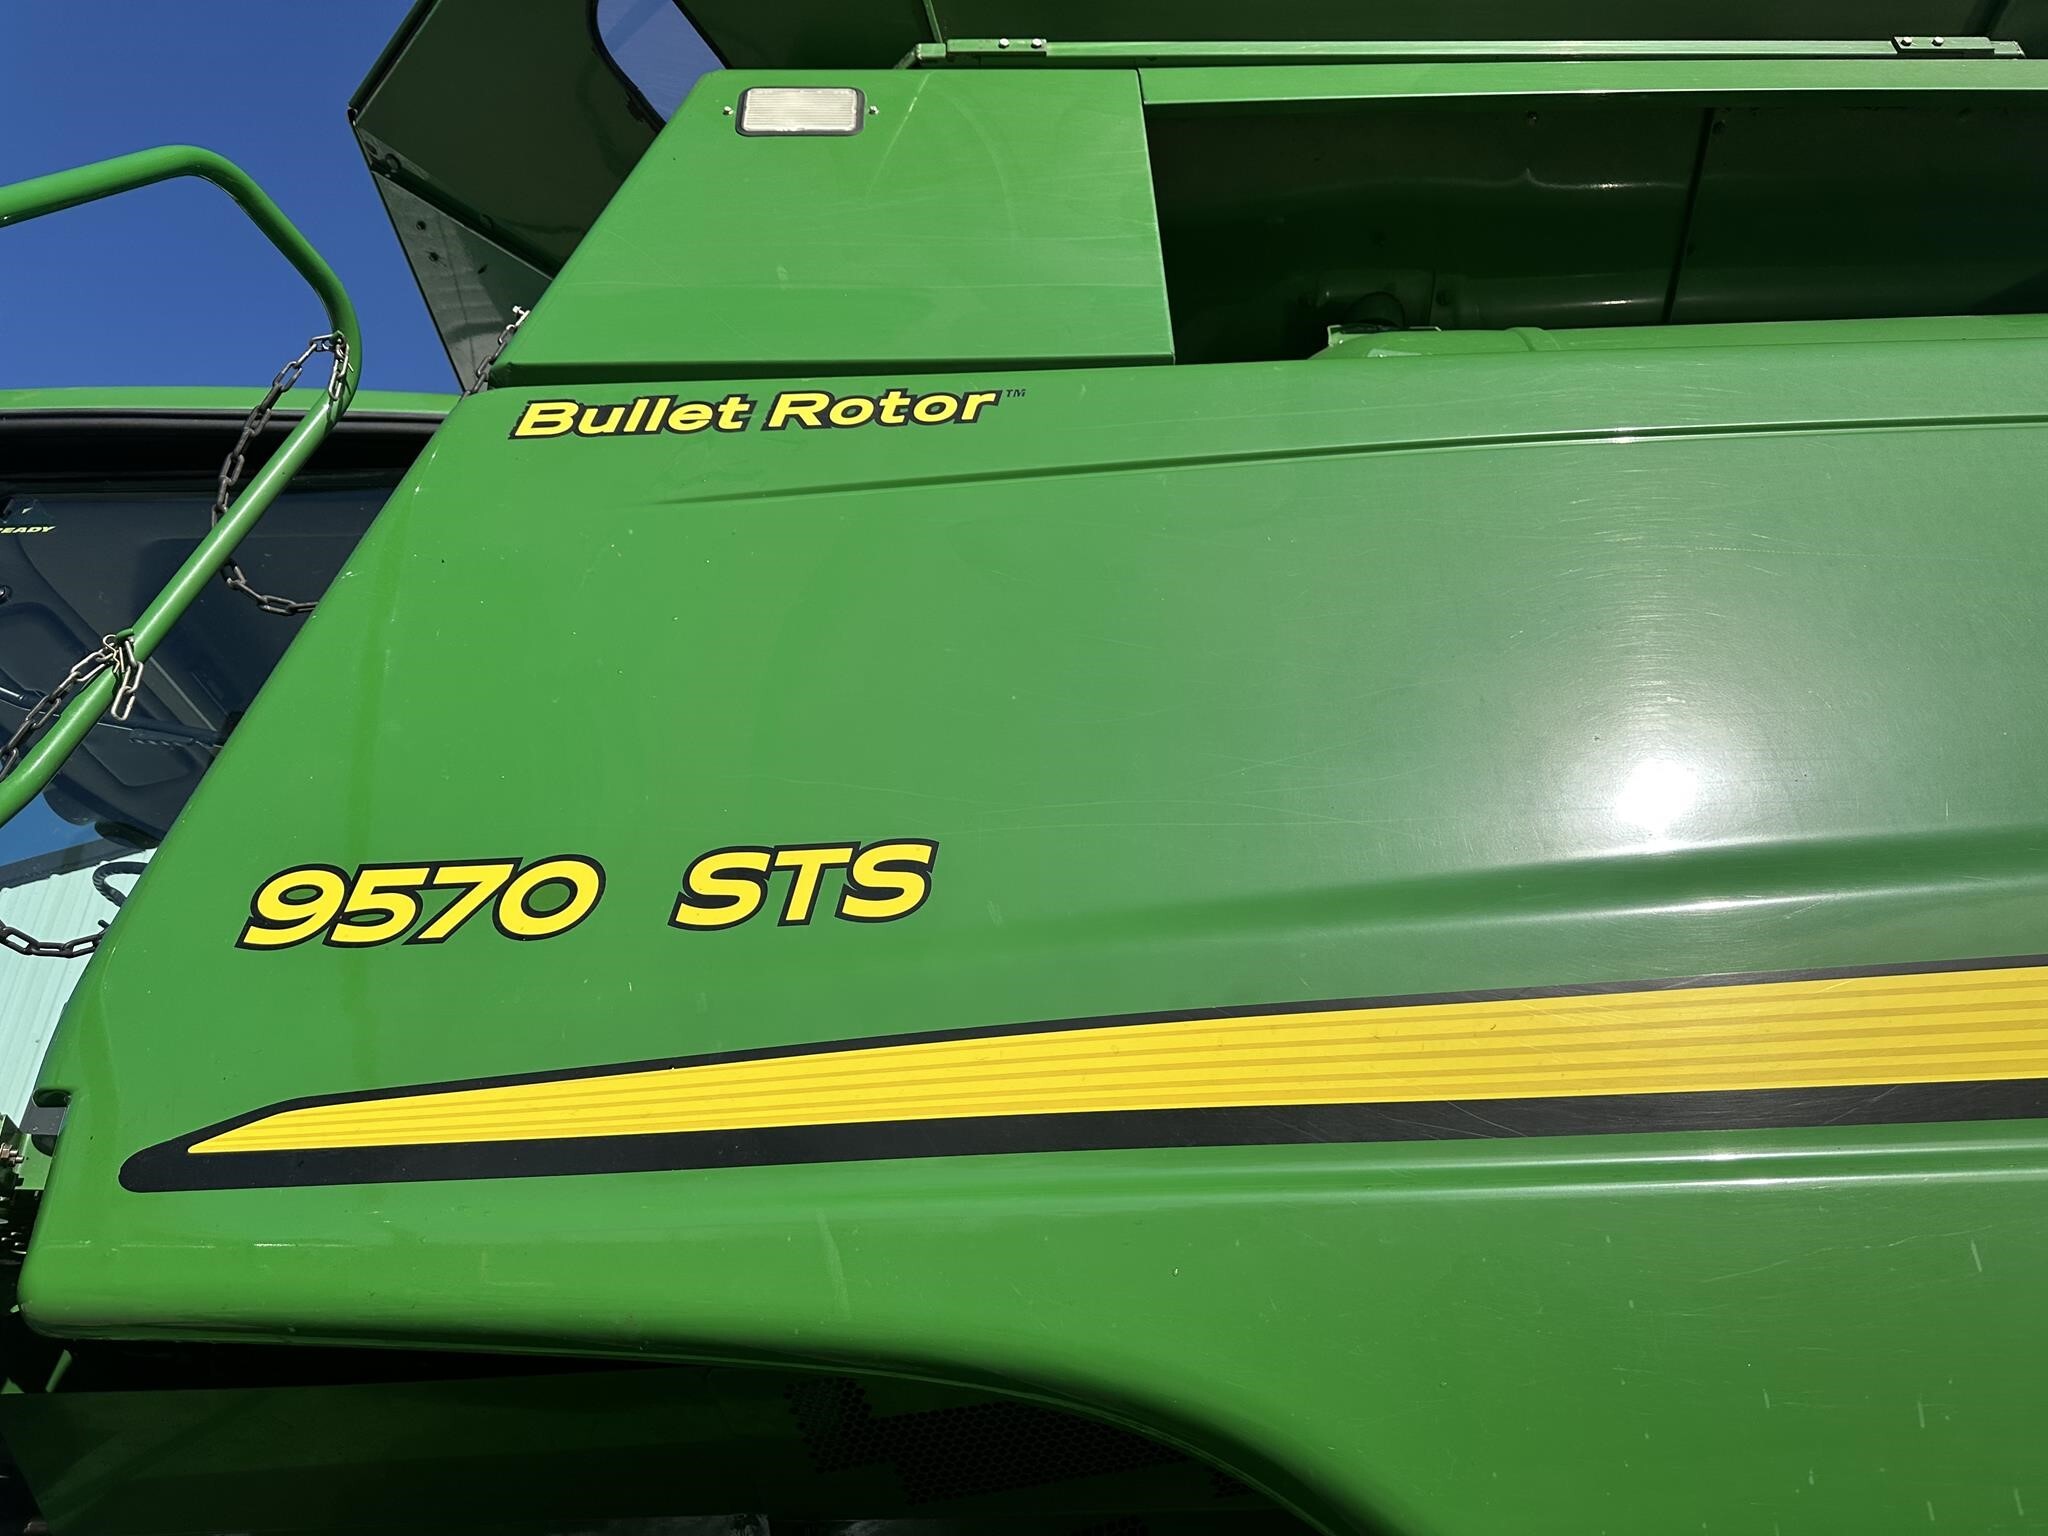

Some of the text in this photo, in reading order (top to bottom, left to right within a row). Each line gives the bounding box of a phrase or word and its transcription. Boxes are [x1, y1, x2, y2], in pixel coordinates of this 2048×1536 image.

[513, 396, 751, 437] Bullet
[767, 390, 998, 428] Rotor
[0, 526, 56, 534] EADY
[240, 841, 936, 947] 9570 STS
